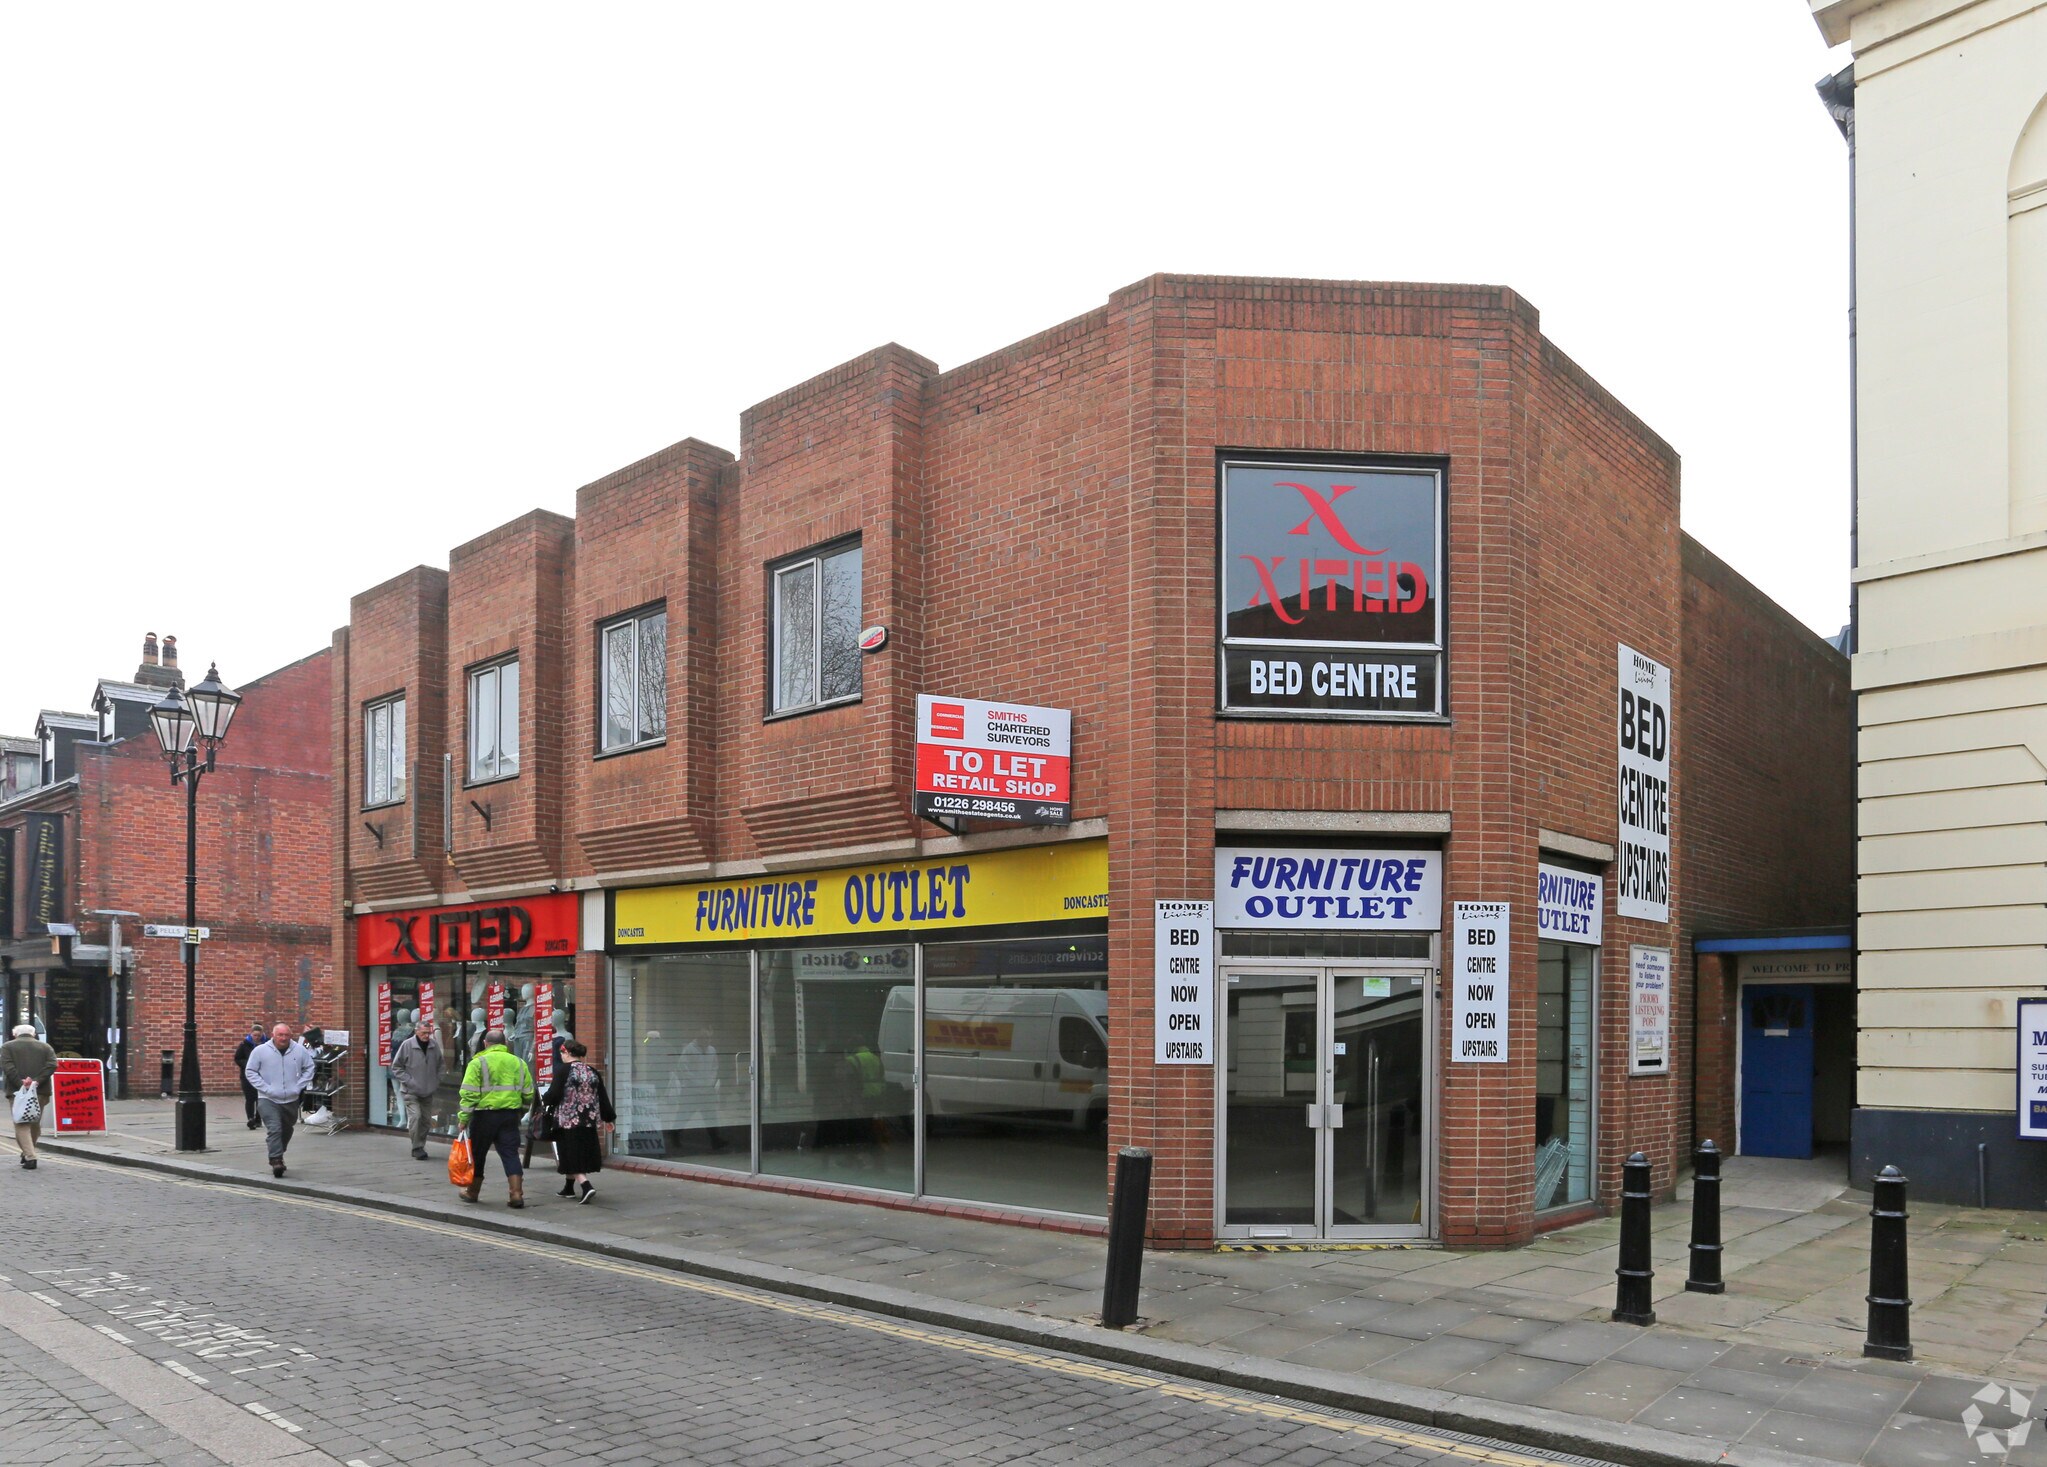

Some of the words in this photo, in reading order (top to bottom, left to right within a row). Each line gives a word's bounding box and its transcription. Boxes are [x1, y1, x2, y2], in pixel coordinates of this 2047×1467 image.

[1273, 482, 1390, 556] X
[1239, 554, 1427, 625] XITED
[1633, 654, 1657, 677] HOME
[1250, 660, 1303, 695] BED
[1311, 661, 1417, 699] CENTRE
[987, 710, 1028, 723] SMITHS
[1621, 687, 1666, 762] BED
[987, 721, 1051, 736] CHARTERED
[987, 732, 1051, 748] SURVEYORS
[943, 749, 983, 773] TO
[993, 754, 1047, 779] LET
[932, 773, 1000, 792] RETAIL
[1005, 779, 1057, 797] SHOP
[933, 796, 969, 810] 01226
[972, 800, 1016, 813] 298456
[1620, 764, 1667, 836] CENTRE
[927, 806, 1021, 820] www.smithsestateagents.co.uk
[39, 821, 55, 855] Gold
[1231, 856, 1426, 893] FURNITURE
[1619, 839, 1668, 906] UPSTAIRS
[36, 859, 54, 924] Workshop
[696, 879, 818, 932] FURNITURE
[843, 864, 971, 925] OUTLET
[1159, 903, 1209, 911] HOME
[1163, 911, 1203, 920] Living
[1245, 896, 1413, 919] OUTLET
[1457, 904, 1506, 912] HOME
[1462, 911, 1501, 920] Living
[385, 905, 532, 963] XITED
[618, 927, 644, 937] DONCASTER
[1170, 929, 1199, 946] BED
[1468, 928, 1496, 946] BED
[1170, 957, 1200, 975] CENTRE
[1467, 956, 1496, 974] CENTRE
[1643, 952, 1649, 960] Do
[1650, 954, 1658, 962] you
[1644, 972, 1656, 980] listen
[1647, 964, 1665, 972] someone
[1752, 964, 1809, 973] WELCOME
[1814, 963, 1830, 972] TO
[1171, 985, 1198, 1003] NOW
[1468, 984, 1494, 1001] NOW
[1645, 982, 1664, 990] problem?
[1635, 1004, 1664, 1017] LISTENING
[1169, 1013, 1200, 1031] OPEN
[1466, 1012, 1496, 1030] OPEN
[1642, 1016, 1656, 1027] POST
[1166, 1042, 1203, 1059] UPSTAIRS
[1462, 1040, 1498, 1058] UPSTAIRS
[60, 1086, 98, 1097] Fashion
